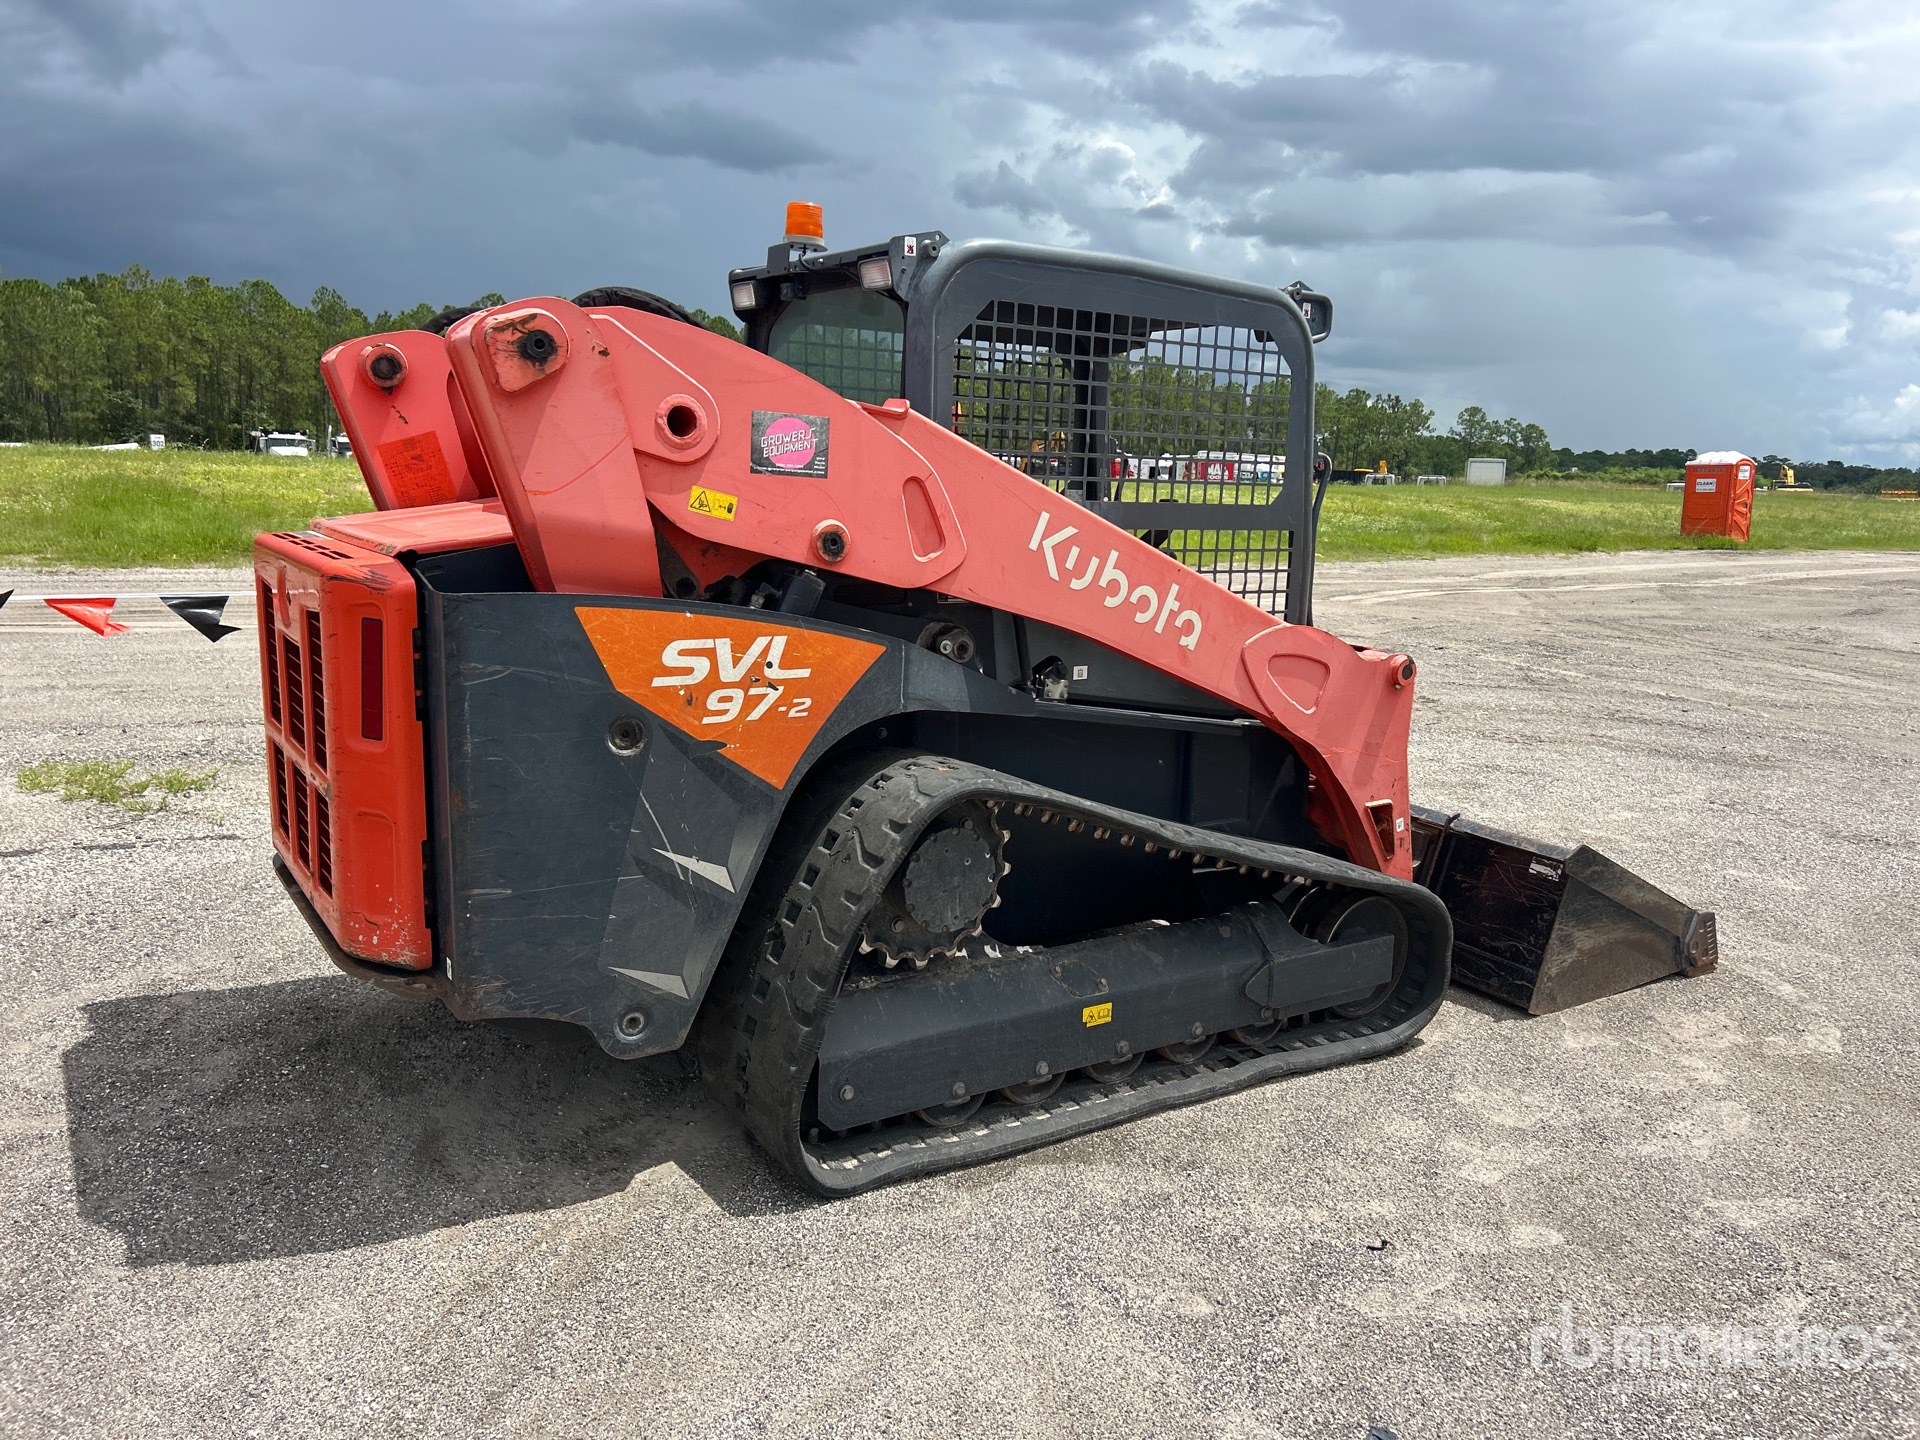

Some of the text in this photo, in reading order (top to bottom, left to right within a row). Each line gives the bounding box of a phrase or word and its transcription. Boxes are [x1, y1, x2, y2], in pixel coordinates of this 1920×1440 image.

[761, 427, 816, 447] GROWERS
[763, 438, 818, 458] EQUIPMENT
[1028, 511, 1203, 651] Kubota
[650, 635, 812, 687] SVL
[701, 685, 812, 725] 97-2
